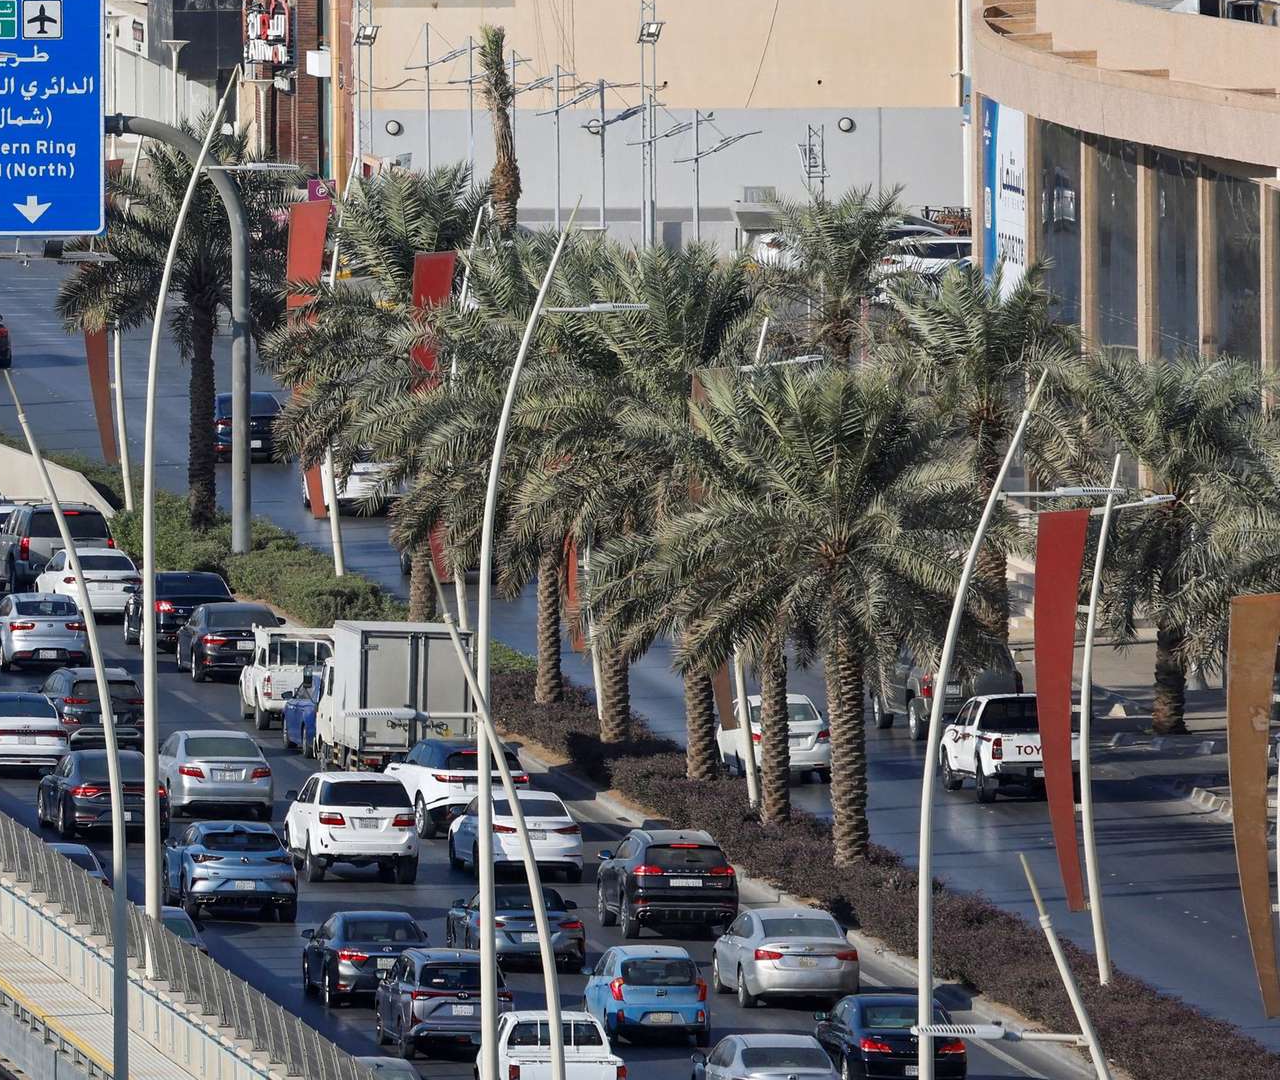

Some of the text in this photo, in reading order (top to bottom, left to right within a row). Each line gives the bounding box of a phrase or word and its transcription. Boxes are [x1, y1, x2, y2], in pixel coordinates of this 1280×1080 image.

[20, 76, 94, 101] الدائري
[36, 140, 77, 158] Ring
[6, 163, 75, 179] (North)
[1016, 745, 1043, 756] TOY
